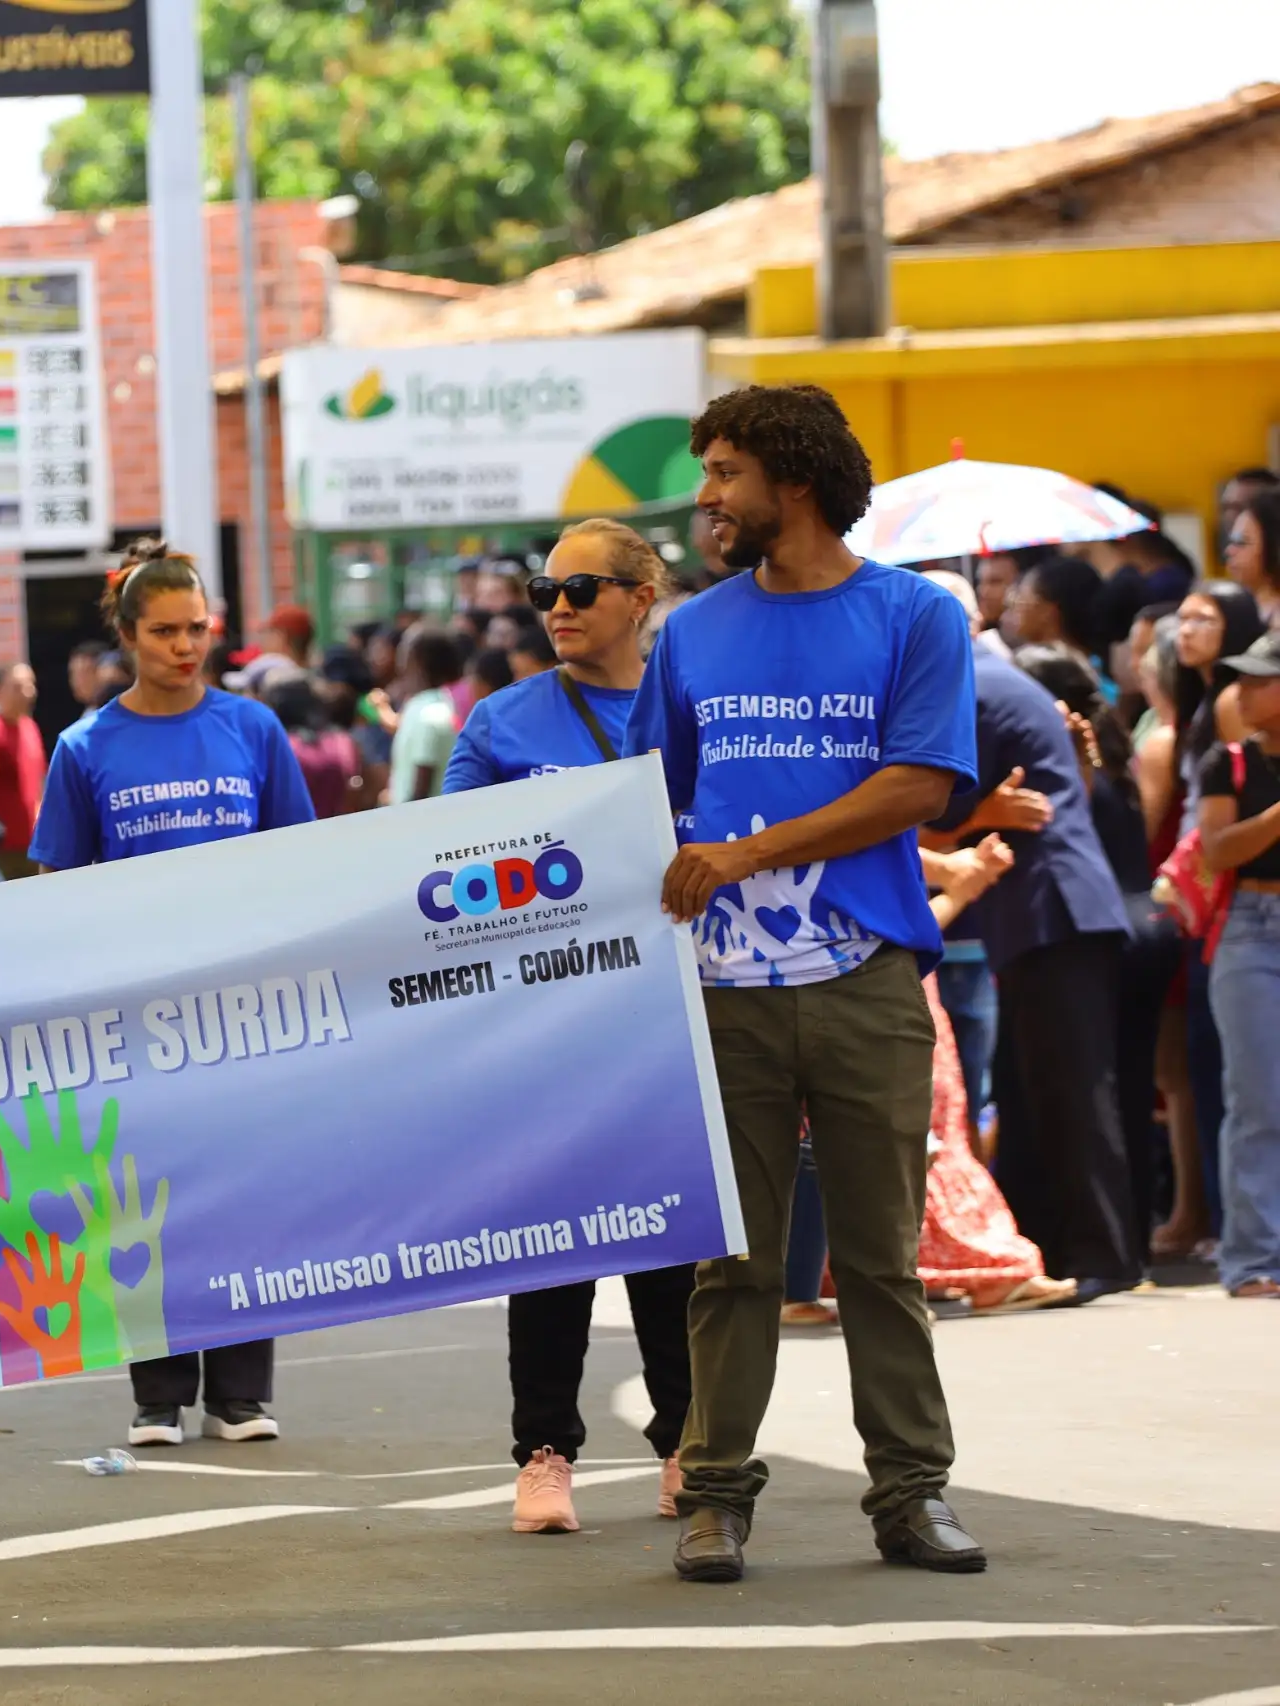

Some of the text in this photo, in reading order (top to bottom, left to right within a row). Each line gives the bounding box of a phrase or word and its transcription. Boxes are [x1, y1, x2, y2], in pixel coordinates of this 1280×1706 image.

[695, 693, 876, 727] SETEMBRO AZUL
[702, 734, 880, 766] Visibilidade Surda
[110, 777, 254, 811] SETEMBRO AZUL
[116, 808, 212, 840] Visibilidade
[435, 832, 552, 863] PREFEITURA DE
[417, 840, 583, 923] CODÓ
[435, 918, 581, 952] Secretaria Municipal de Educação
[448, 915, 518, 937] TRABALHO
[523, 914, 530, 923] E
[535, 902, 588, 920] FUTURO
[388, 960, 496, 1009] SEMECTI
[519, 936, 641, 986] CODÓ/MA
[142, 967, 353, 1073] SURDA
[256, 1252, 390, 1306] inclusao
[397, 1220, 574, 1280] transforma
[579, 1194, 682, 1247] vidas”
